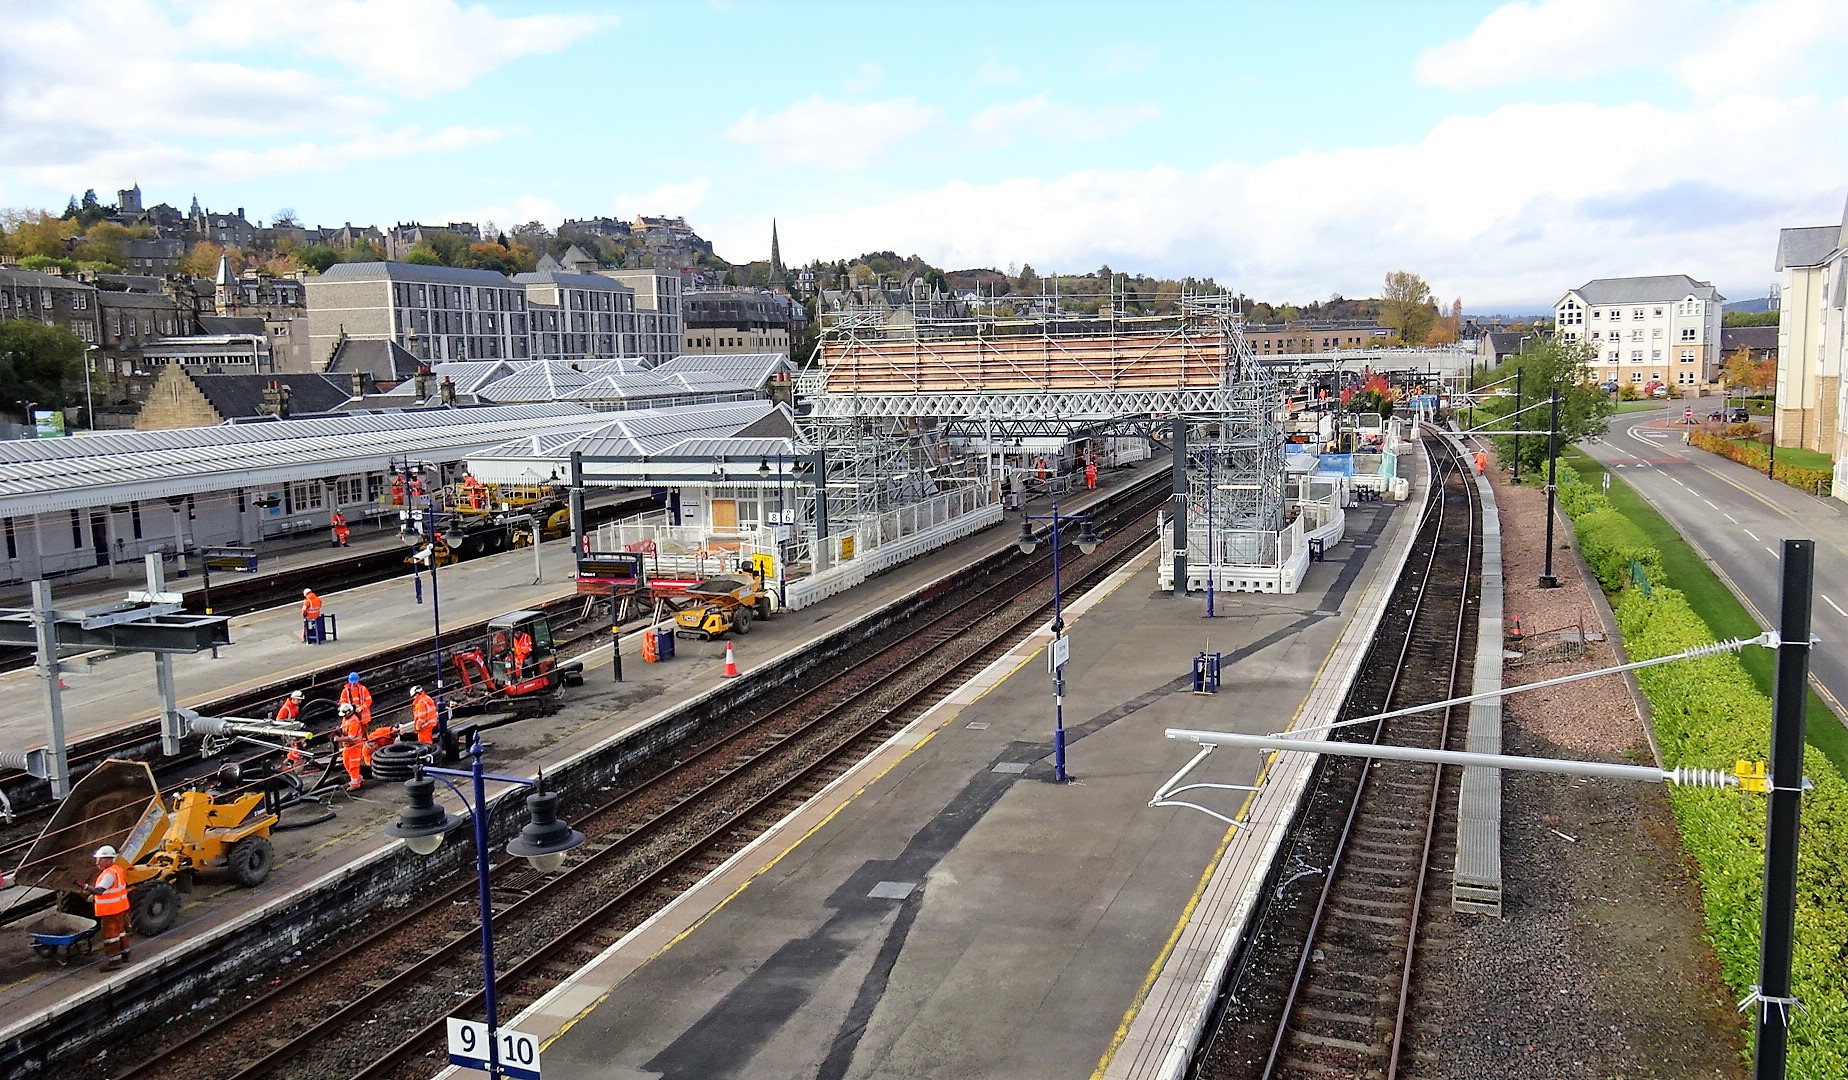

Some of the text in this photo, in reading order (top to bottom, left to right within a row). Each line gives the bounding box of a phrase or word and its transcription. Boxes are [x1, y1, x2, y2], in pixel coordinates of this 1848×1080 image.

[771, 513, 777, 522] 8
[785, 513, 791, 522] 6
[460, 1025, 476, 1052] 9
[503, 1034, 534, 1065] 10
